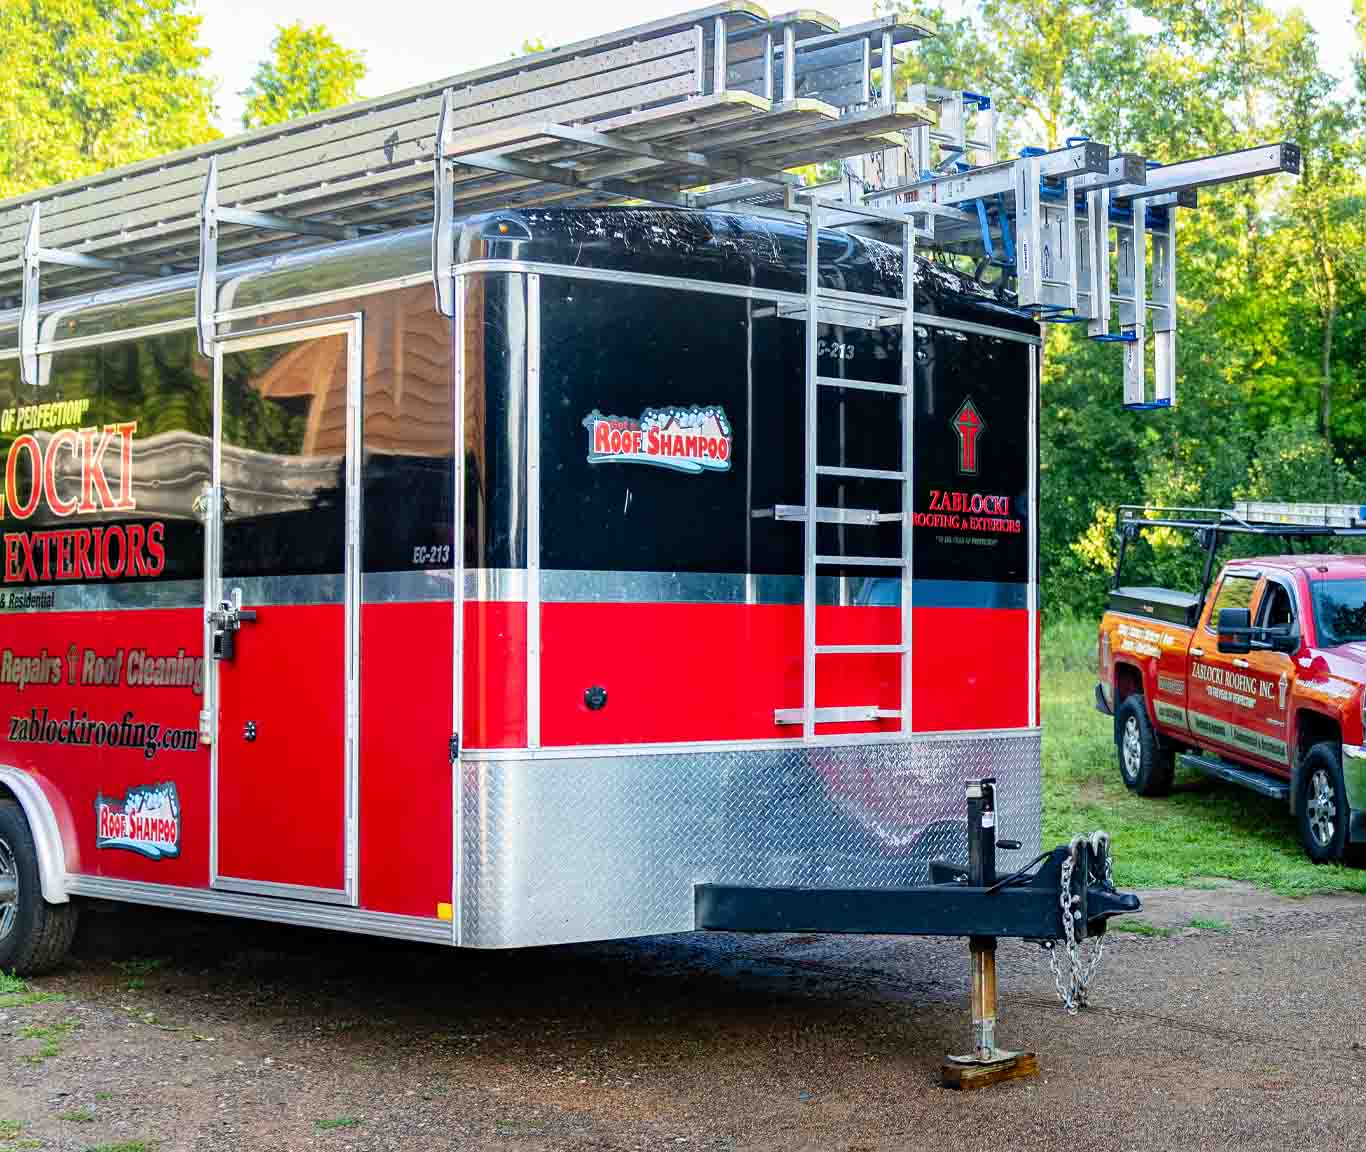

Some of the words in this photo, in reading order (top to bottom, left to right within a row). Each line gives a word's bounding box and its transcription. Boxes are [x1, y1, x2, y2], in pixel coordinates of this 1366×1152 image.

[817, 339, 855, 360] C-213
[1, 408, 15, 432] OF
[16, 399, 89, 430] PERFECTION"
[594, 421, 642, 455] ROOF
[647, 426, 730, 461] SHAMPOO
[0, 421, 138, 520] OCKI
[929, 489, 1009, 516] ZABLOCKI
[969, 516, 1021, 533] EXTERIORS
[3, 521, 166, 583] EXTERIORS
[412, 544, 450, 564] EC-213
[8, 591, 55, 609] Residential
[1, 649, 62, 692] Repairs
[81, 649, 124, 686] Roof
[127, 649, 205, 694] Cleaning
[1225, 670, 1257, 696] ROOFING
[8, 707, 198, 759] zablockiroofing.com
[101, 805, 127, 838] ROOF
[129, 808, 178, 844] SHAMPOO
